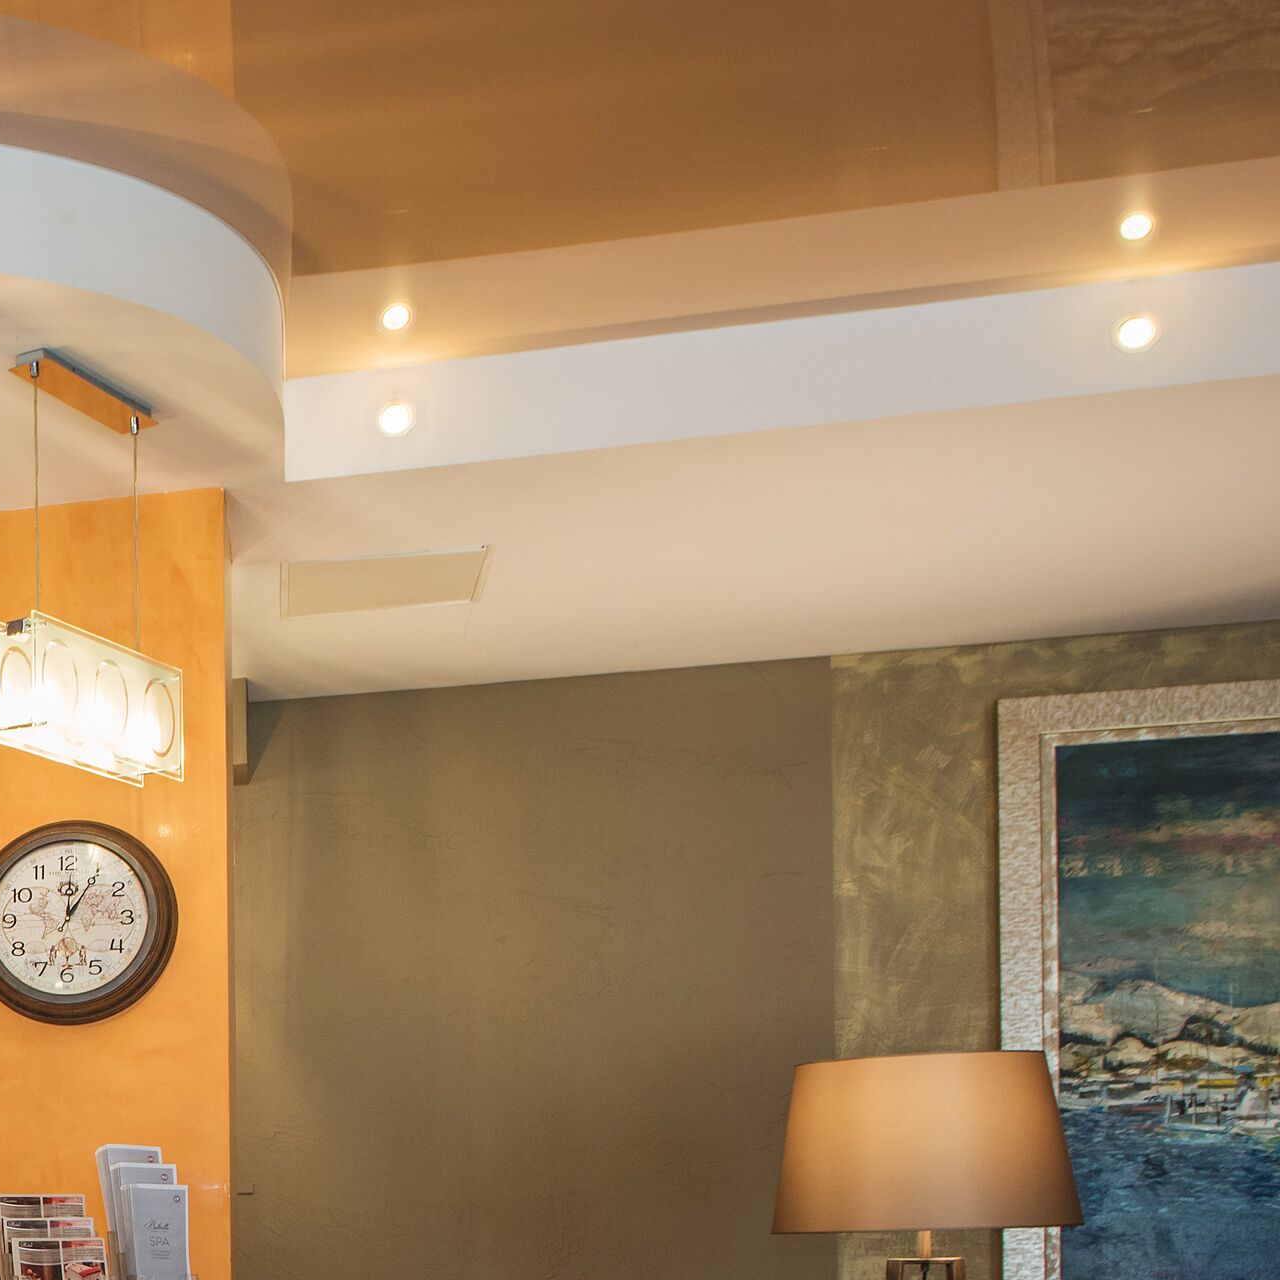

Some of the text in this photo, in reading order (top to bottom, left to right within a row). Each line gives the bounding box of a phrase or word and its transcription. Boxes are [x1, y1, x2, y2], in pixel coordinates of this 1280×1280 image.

[57, 855, 78, 871] 12
[32, 864, 46, 880] 11
[11, 887, 33, 904] 10
[111, 881, 126, 897] 2
[2, 913, 17, 929] 9
[119, 909, 135, 926] 3
[11, 941, 26, 957] 8
[109, 938, 125, 954] 4
[34, 961, 49, 977] 7
[59, 966, 75, 983] 6
[88, 959, 103, 976] 5
[149, 1236, 170, 1247] SPA
